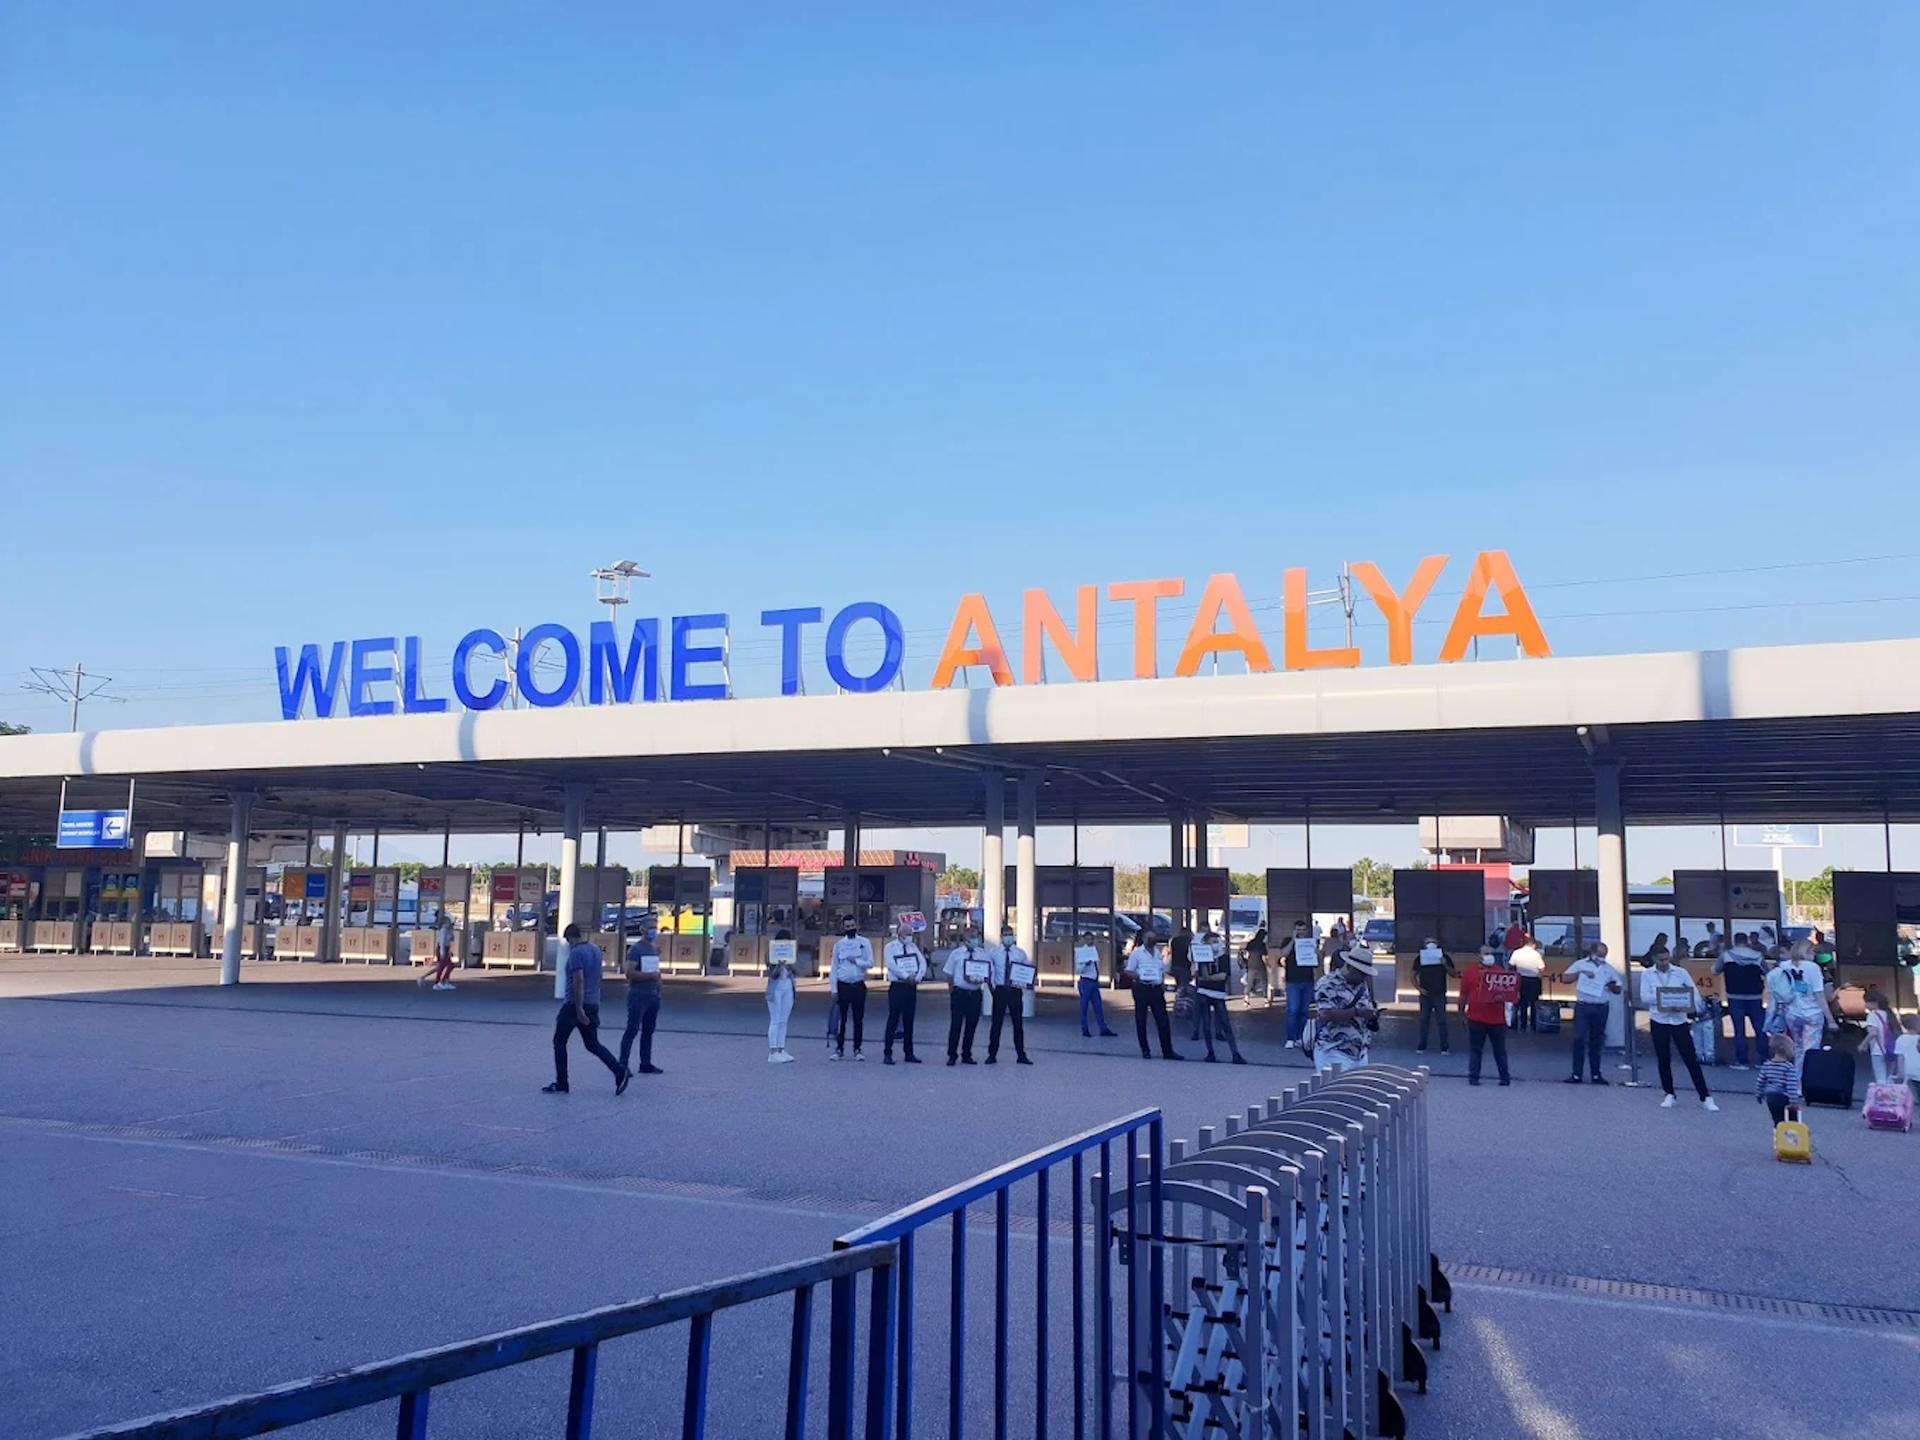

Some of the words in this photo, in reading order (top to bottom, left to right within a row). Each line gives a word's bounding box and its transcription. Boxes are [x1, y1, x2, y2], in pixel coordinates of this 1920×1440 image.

[274, 613, 730, 720] WELCOME
[760, 602, 905, 695] TO
[931, 549, 1552, 690] ANTALYA
[517, 943, 528, 952] 22
[1697, 976, 1713, 988] 43
